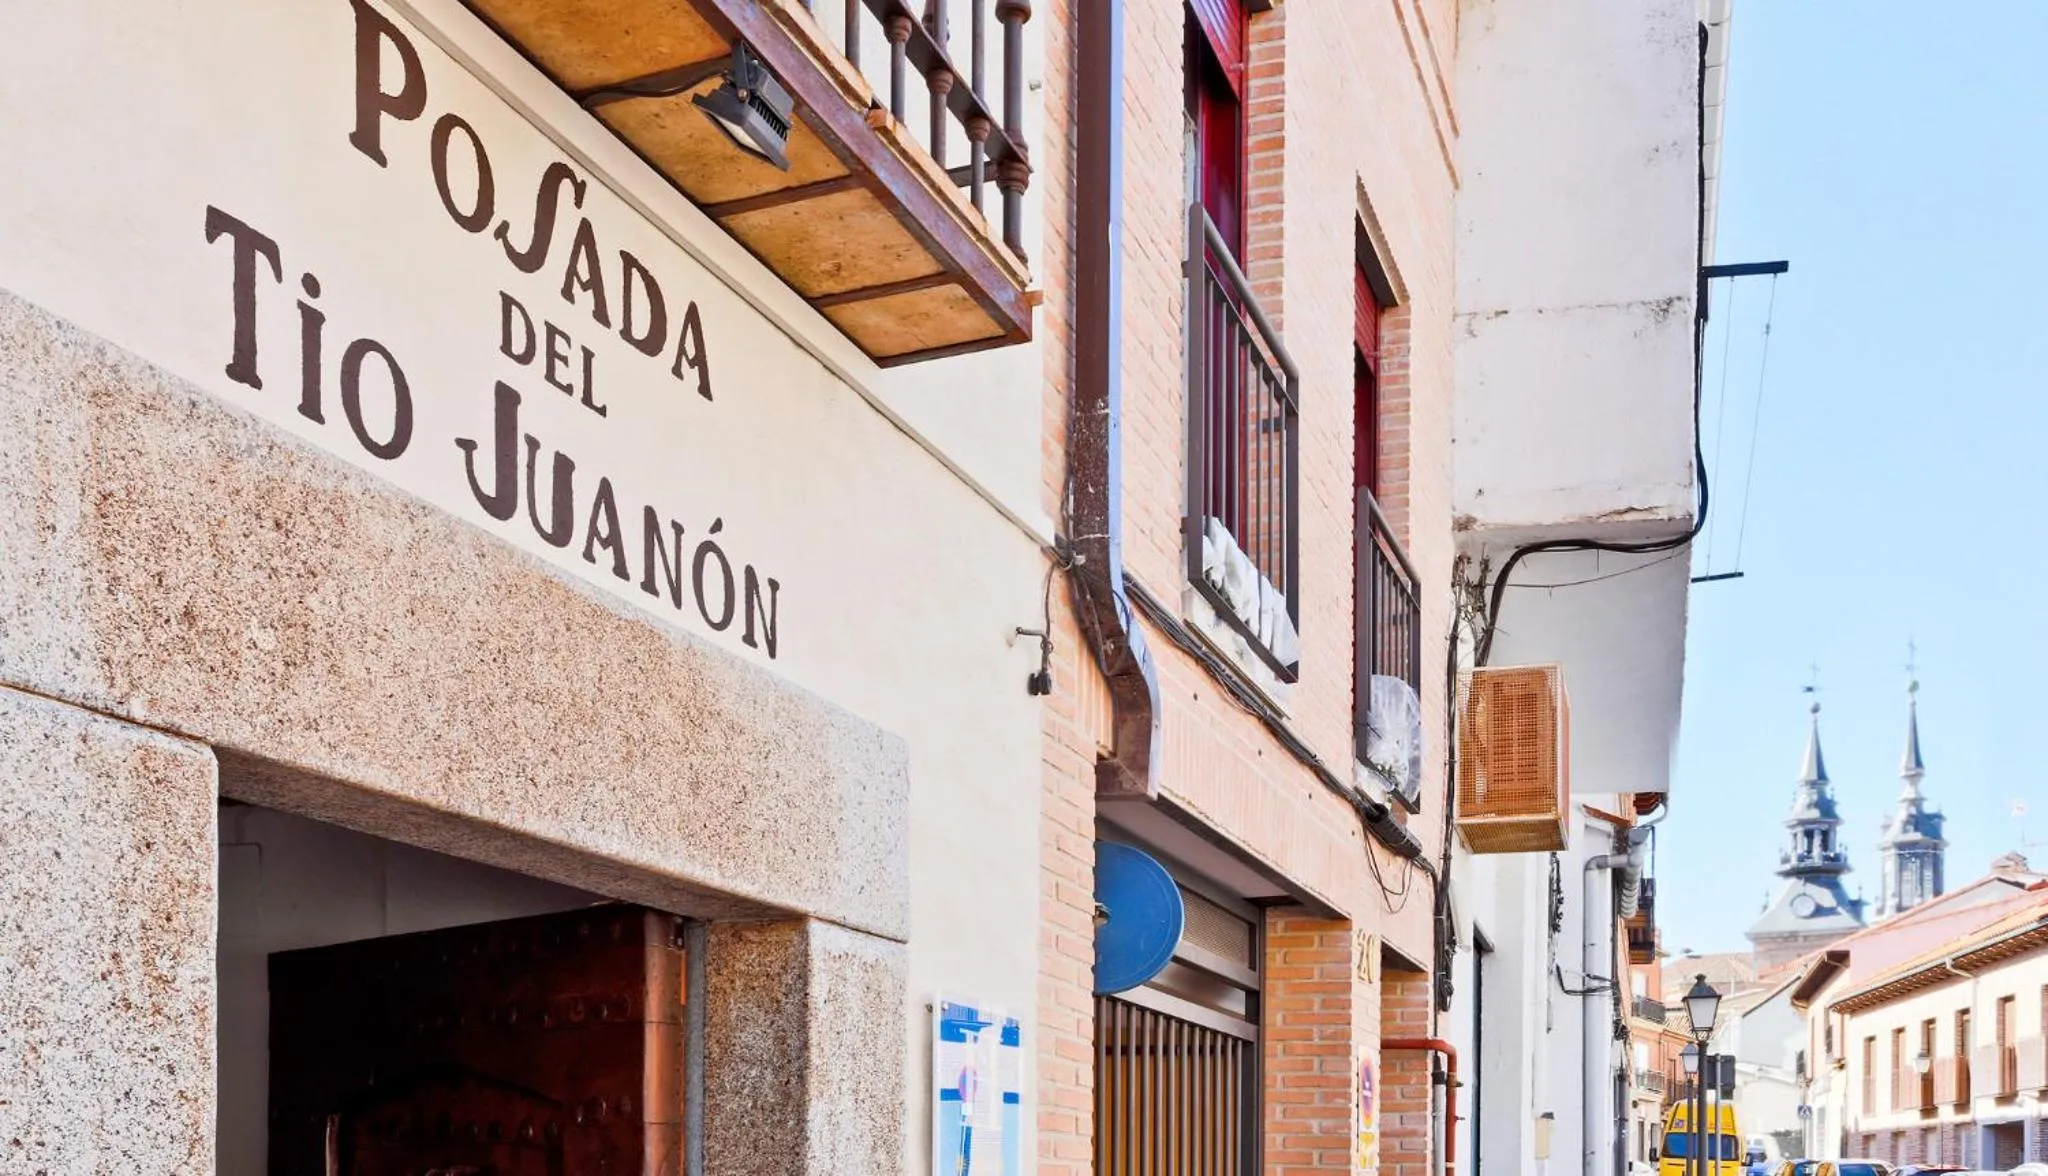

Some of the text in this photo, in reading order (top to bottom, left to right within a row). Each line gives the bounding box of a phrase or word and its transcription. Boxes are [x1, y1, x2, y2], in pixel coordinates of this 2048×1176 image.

[348, 0, 714, 402] POSADA
[499, 290, 607, 419] DEL
[454, 379, 780, 660] JUANÓN
